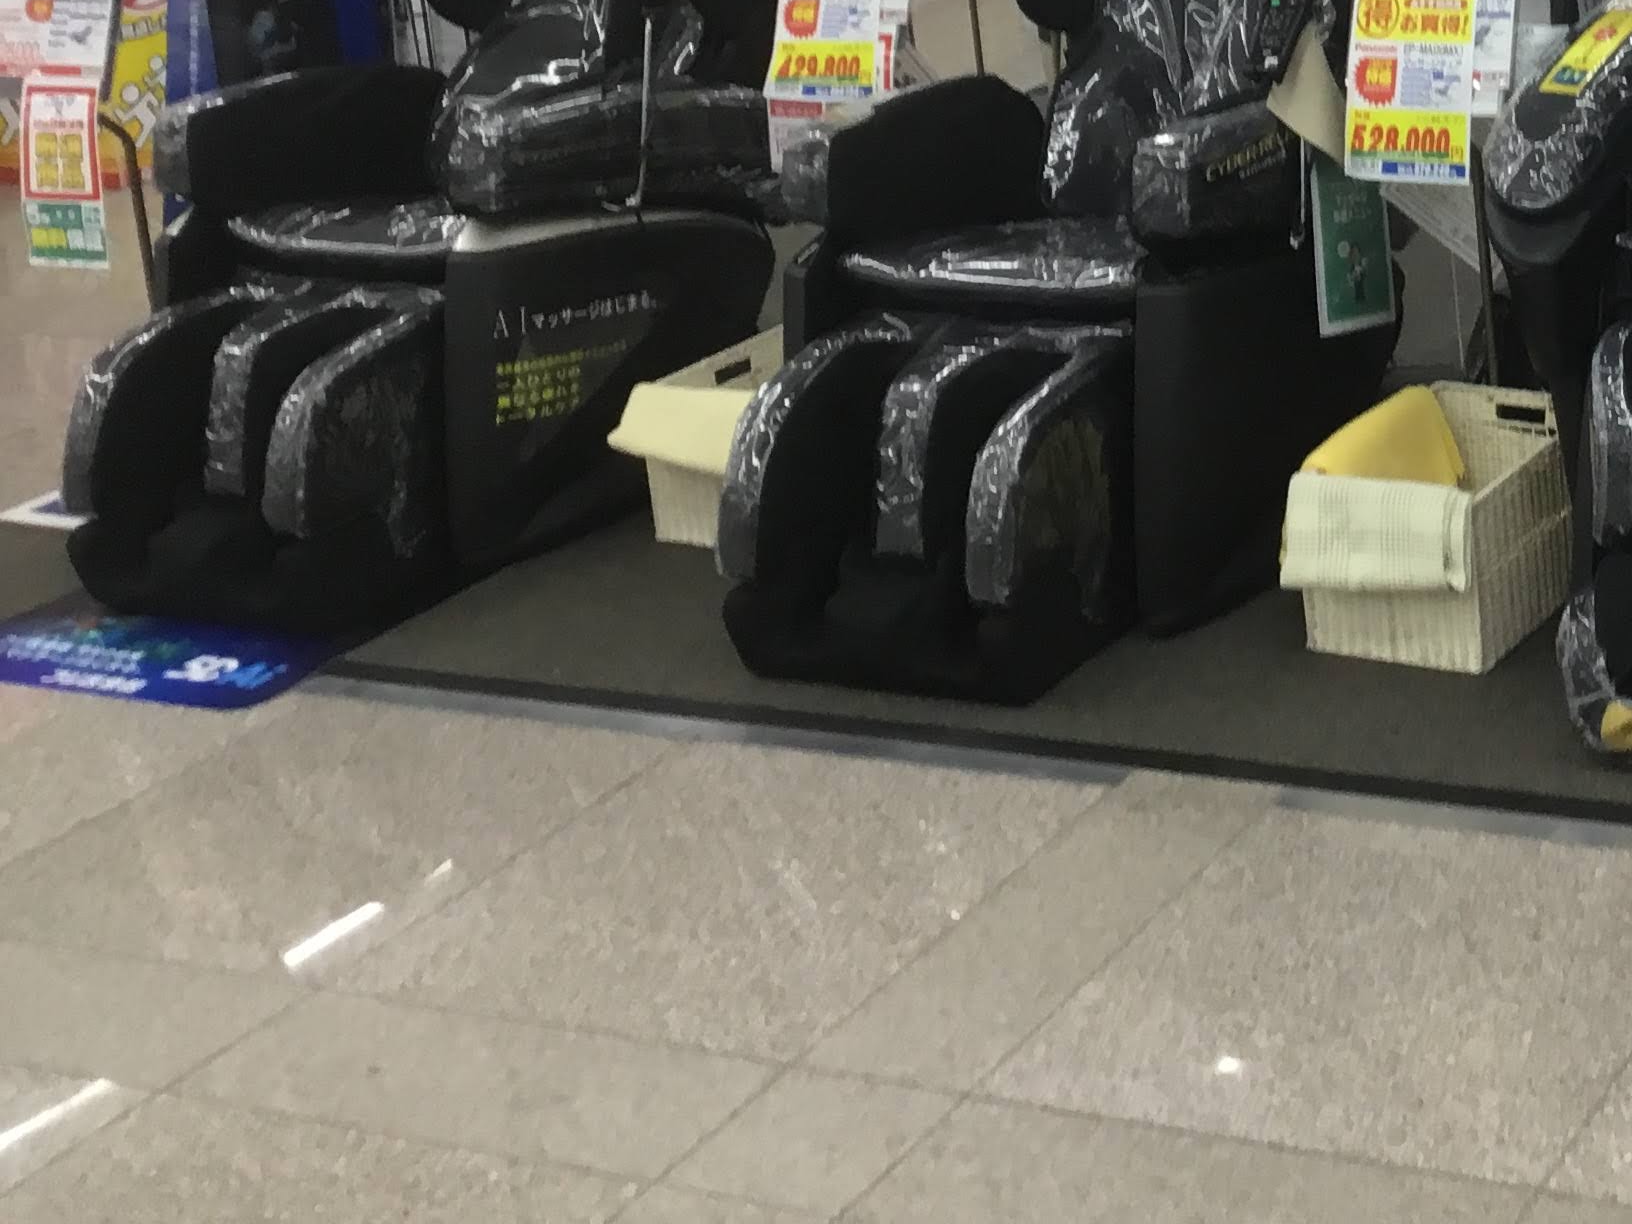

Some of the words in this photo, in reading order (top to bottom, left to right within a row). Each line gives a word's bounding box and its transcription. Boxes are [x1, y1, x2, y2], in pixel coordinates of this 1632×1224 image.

[1400, 13, 1469, 36] お買得!
[1352, 122, 1450, 153] 528,000
